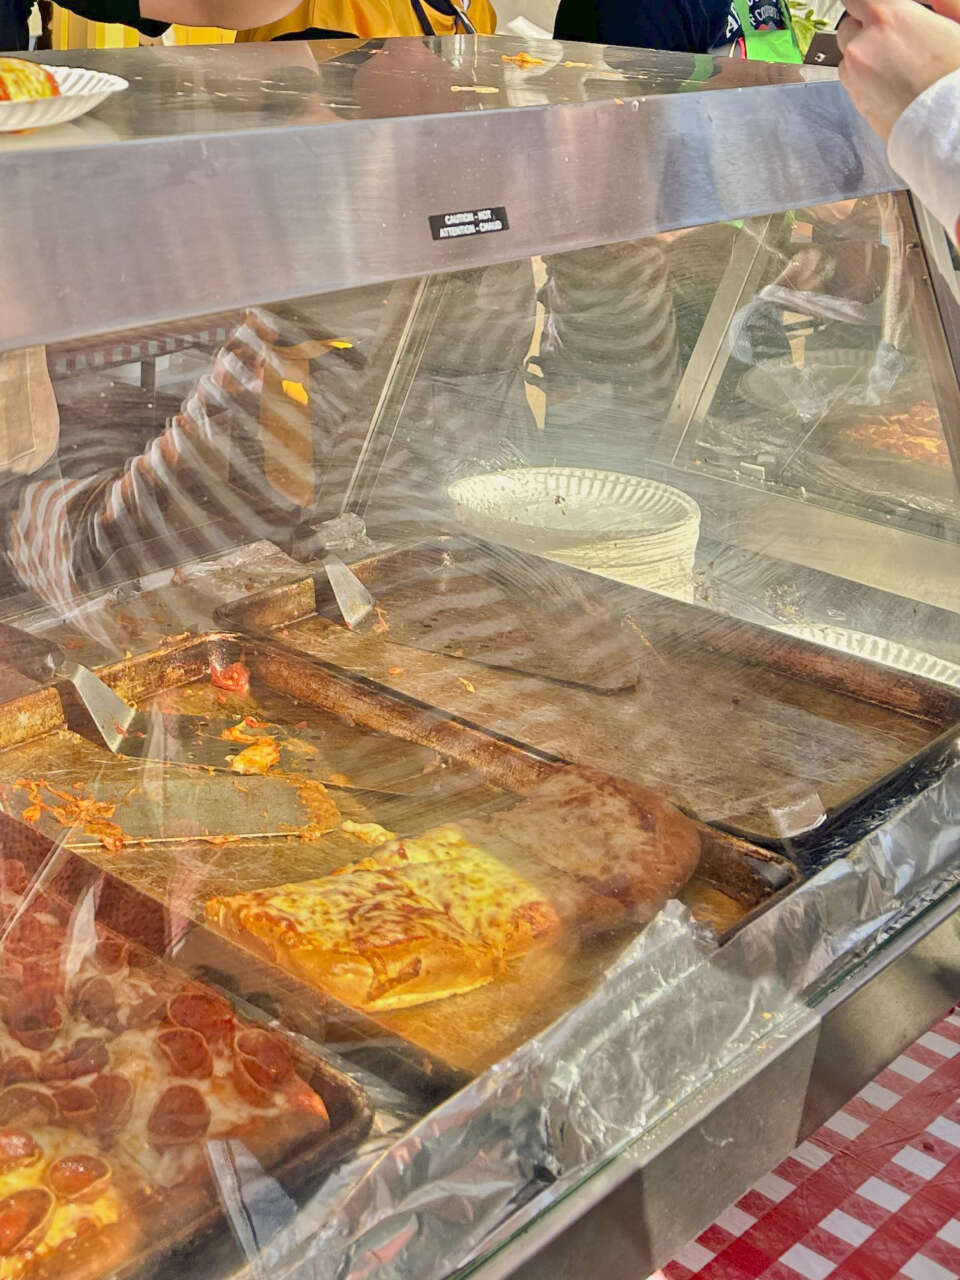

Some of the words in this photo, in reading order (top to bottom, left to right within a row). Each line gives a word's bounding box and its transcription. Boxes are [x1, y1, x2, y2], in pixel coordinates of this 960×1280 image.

[445, 213, 474, 225] CAUTION
[478, 210, 491, 220] HOT
[440, 225, 476, 238] ATTENTION
